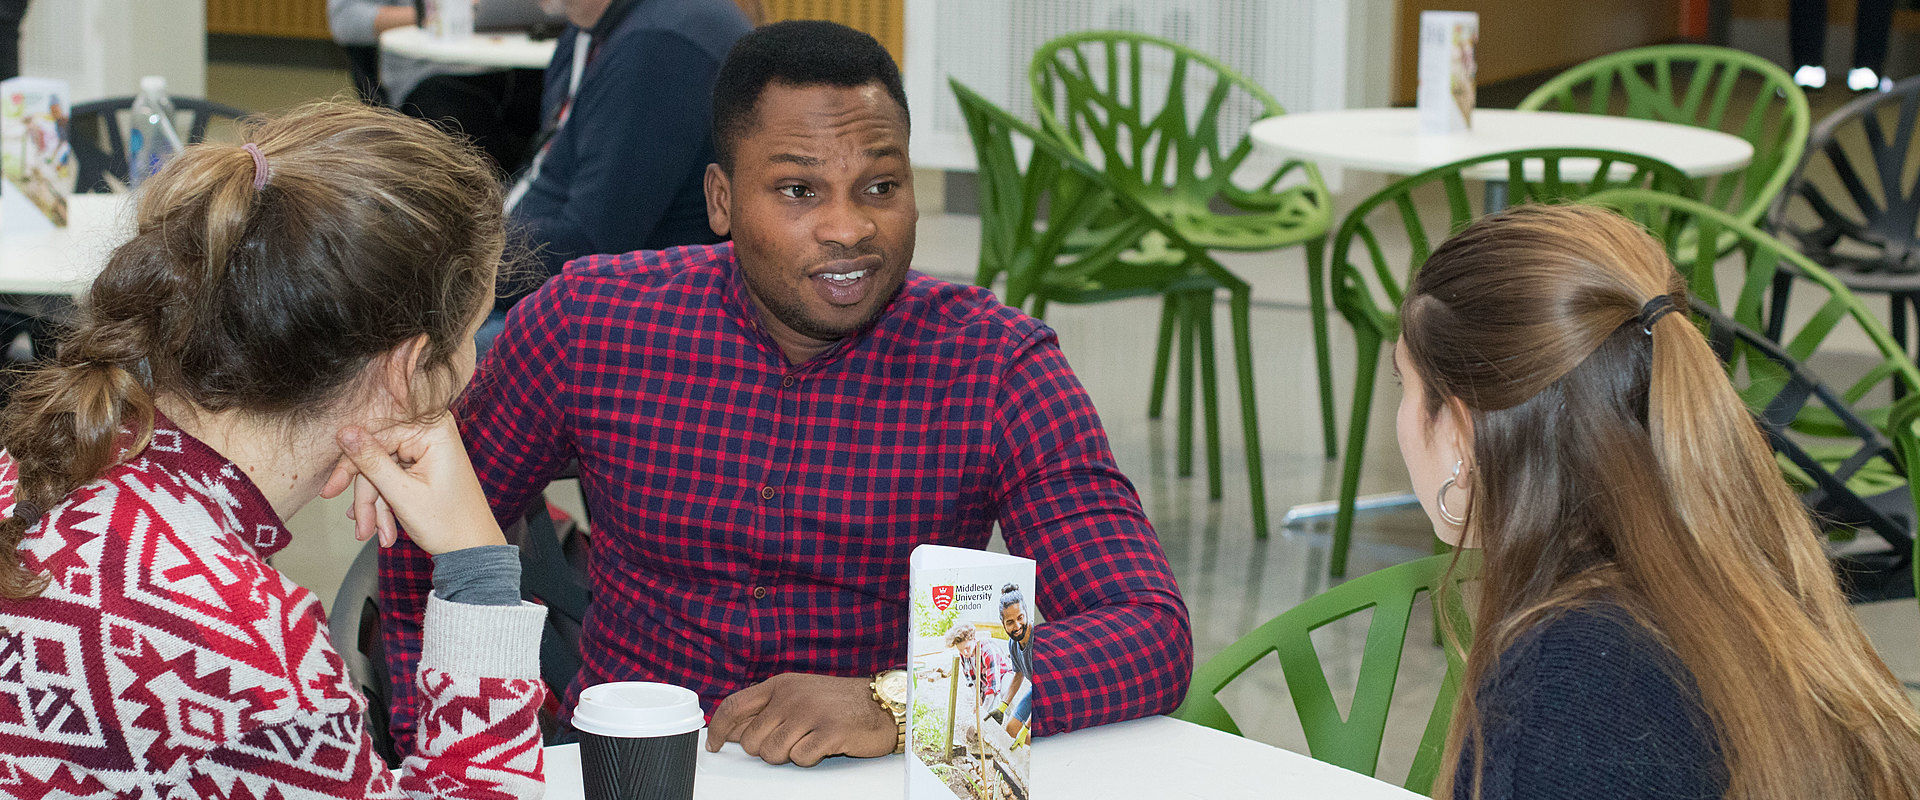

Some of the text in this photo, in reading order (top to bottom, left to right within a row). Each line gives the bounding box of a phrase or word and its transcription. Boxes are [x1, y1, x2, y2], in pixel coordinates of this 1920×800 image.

[955, 583, 993, 593] Middlesex
[955, 592, 992, 602] University
[955, 602, 982, 611] London
